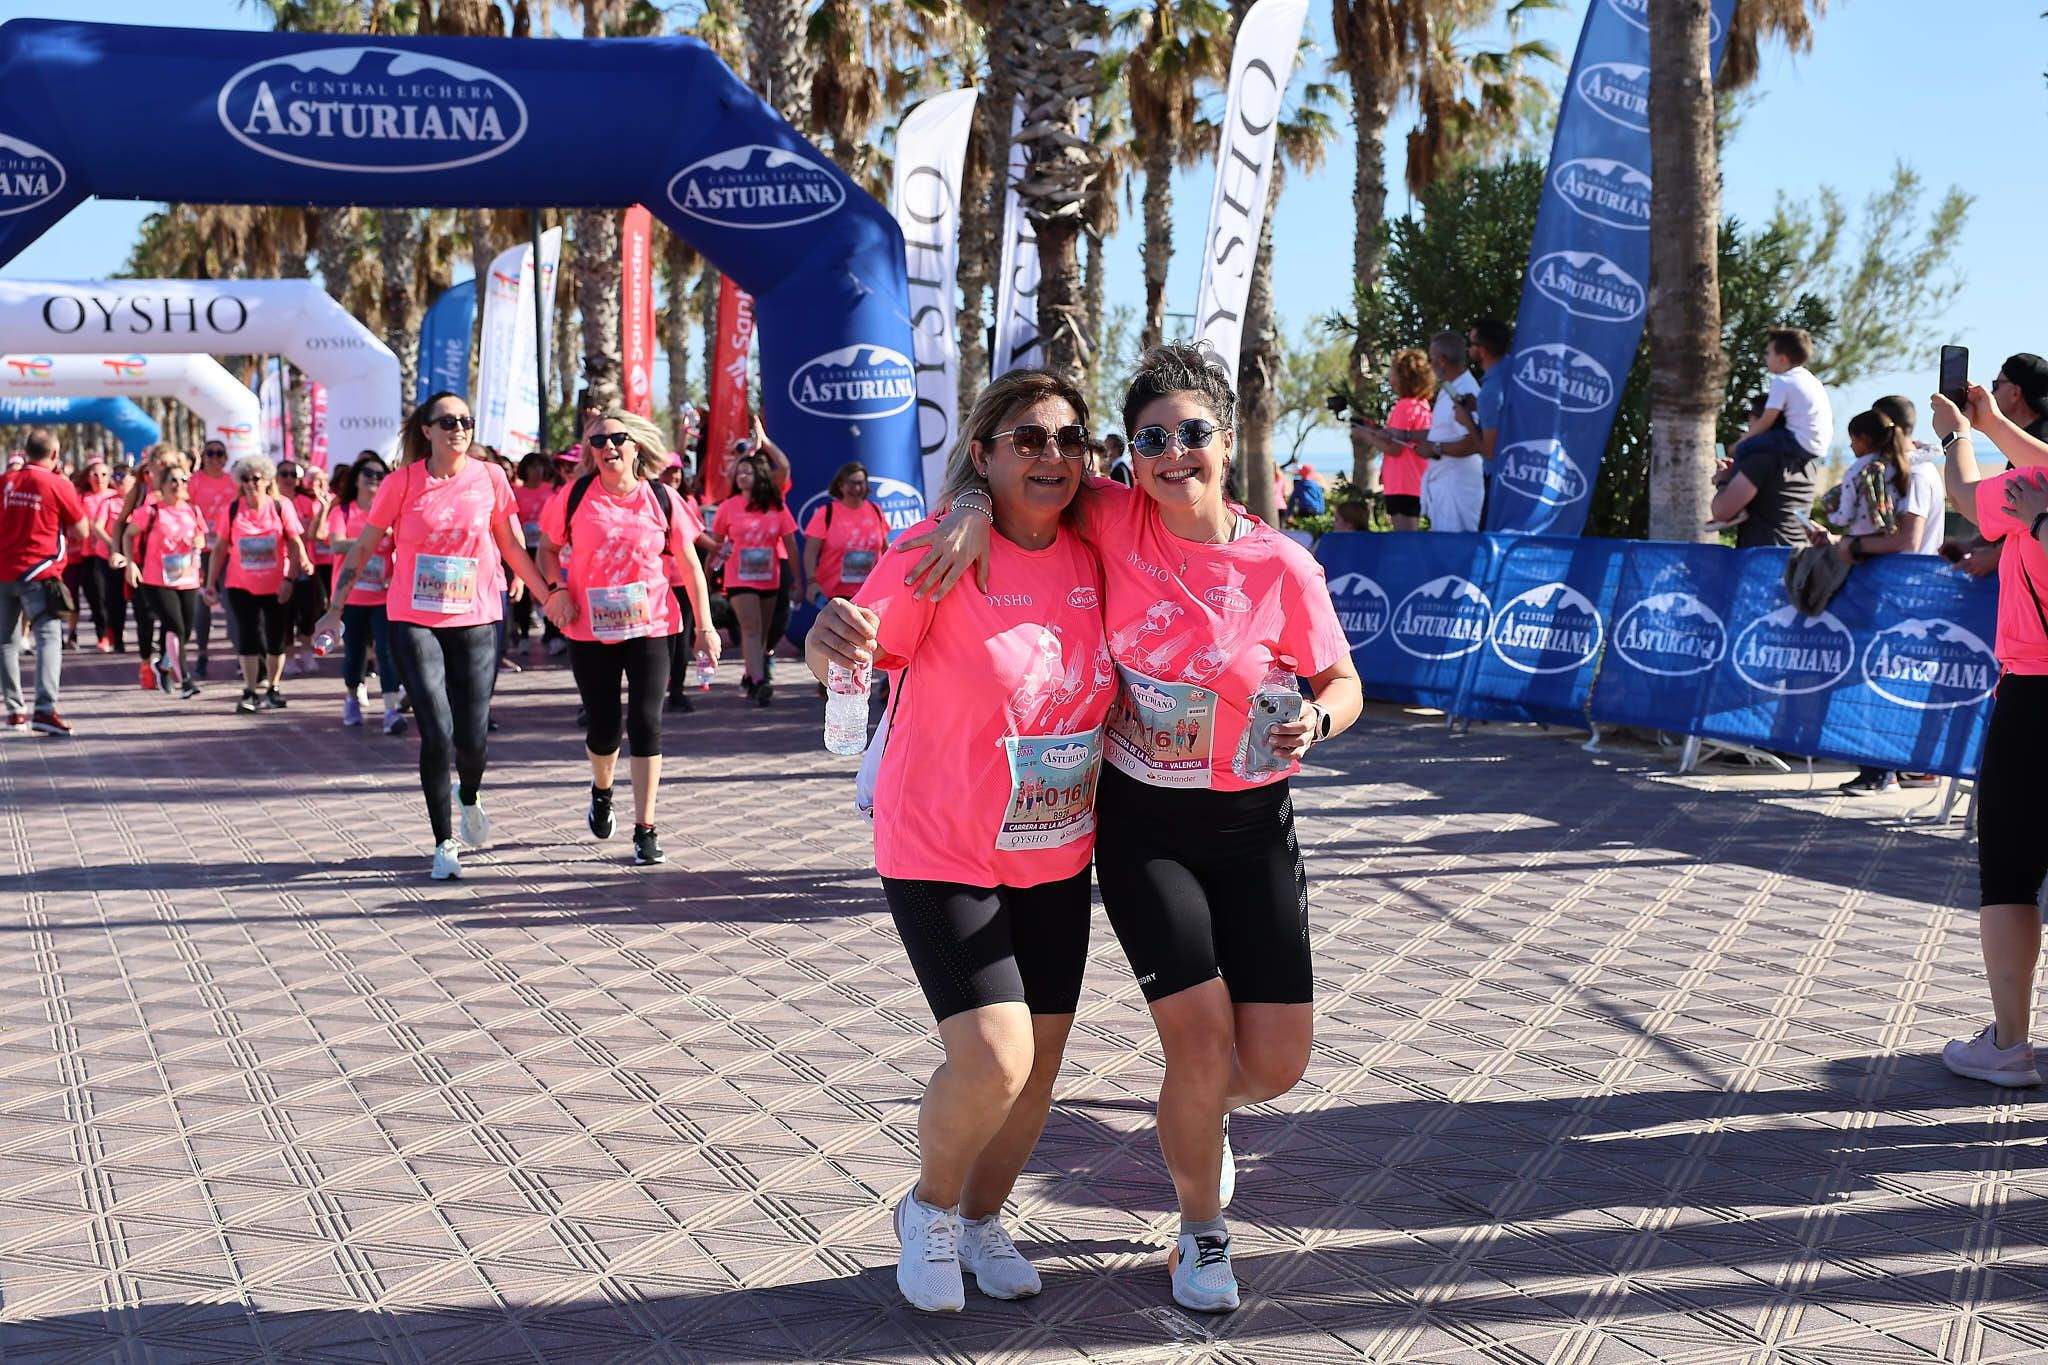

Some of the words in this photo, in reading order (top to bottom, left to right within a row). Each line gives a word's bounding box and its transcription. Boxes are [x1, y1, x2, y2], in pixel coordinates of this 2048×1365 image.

[289, 80, 388, 96] CENTRAL
[397, 84, 495, 100] LECHERA
[243, 80, 506, 141] ASTURIANA
[684, 178, 837, 209] ASTURIANA
[631, 232, 644, 361] Santander
[42, 295, 249, 335] OYSHO
[306, 338, 365, 350] OYSHO
[340, 416, 395, 430] OYSHO
[1397, 604, 1483, 641] ASTURIANA
[1497, 611, 1591, 655] ASTURIANA
[1740, 633, 1842, 673] ASTURIANA
[1108, 745, 1137, 770] OYSHO
[1169, 760, 1202, 769] VALENCIA
[1156, 773, 1196, 784] Santander
[1009, 823, 1038, 831] CARRERA
[1039, 822, 1048, 830] DE
[1048, 821, 1057, 829] LA
[1011, 834, 1048, 846] OYSHO
